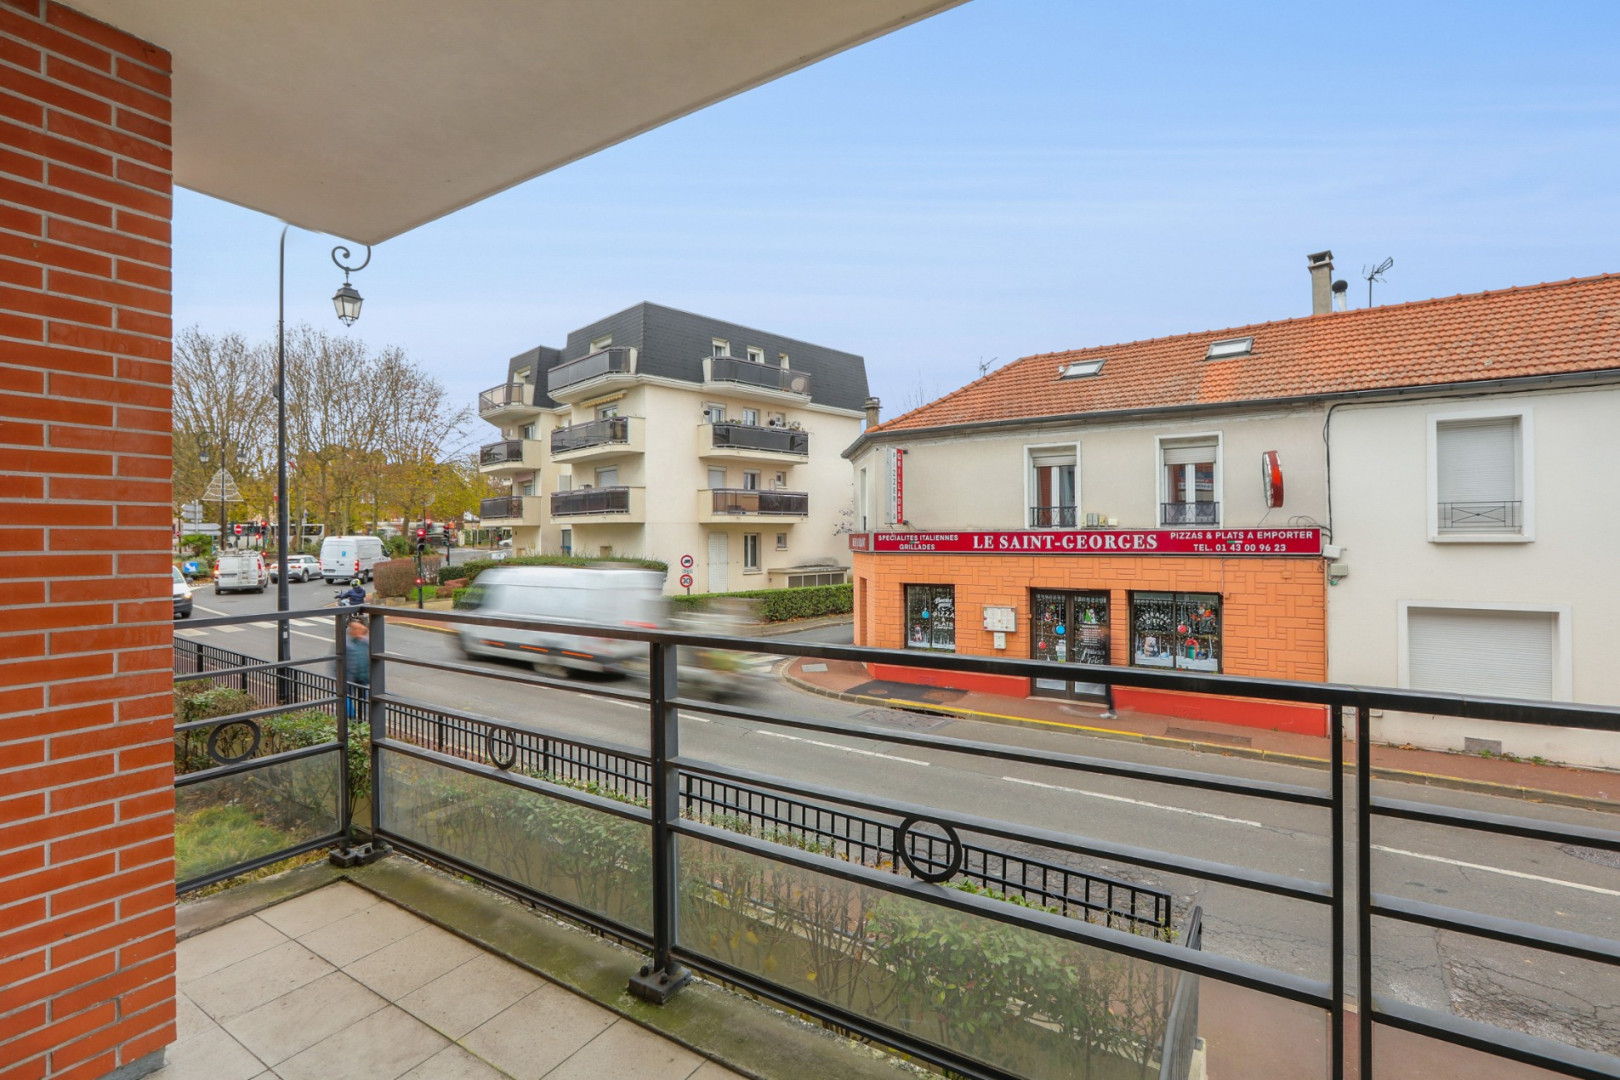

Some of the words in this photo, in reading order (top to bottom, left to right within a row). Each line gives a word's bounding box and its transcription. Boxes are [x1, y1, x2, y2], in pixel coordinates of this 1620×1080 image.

[1215, 531, 1244, 539] PLATS
[1247, 531, 1254, 539] A
[1257, 531, 1313, 539] EMPORTER
[973, 535, 994, 549] LE
[999, 534, 1158, 549] SAINT-GEORGES
